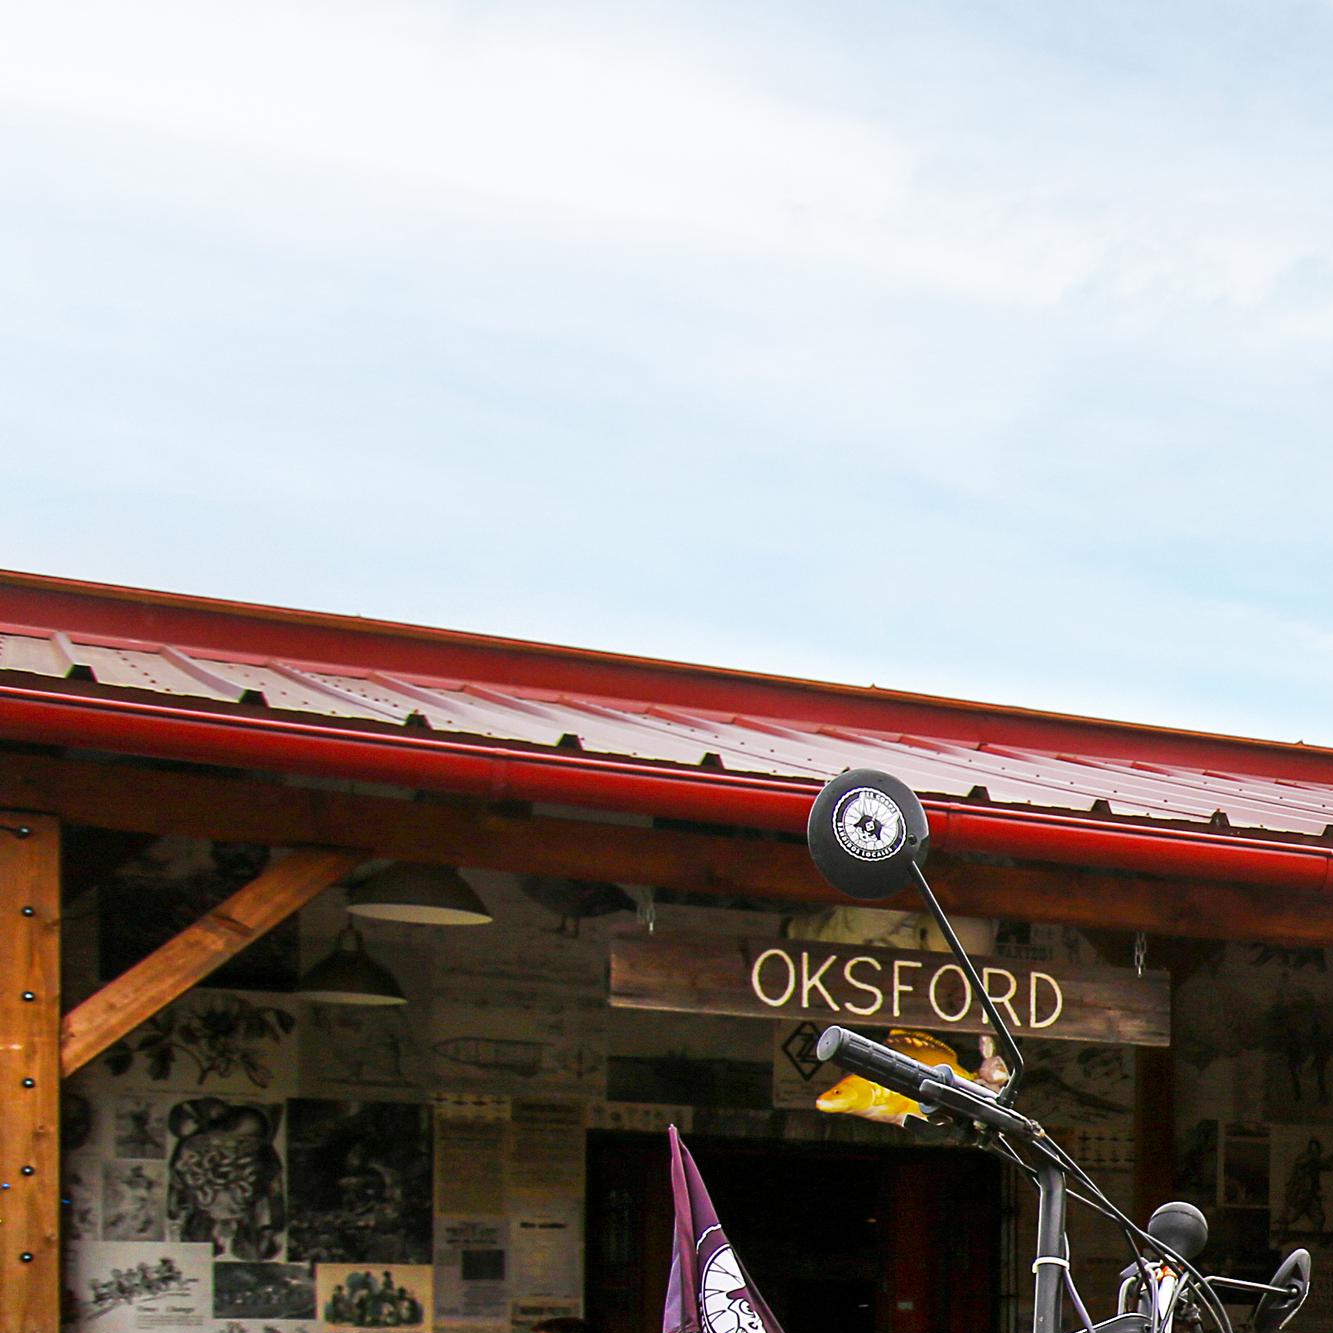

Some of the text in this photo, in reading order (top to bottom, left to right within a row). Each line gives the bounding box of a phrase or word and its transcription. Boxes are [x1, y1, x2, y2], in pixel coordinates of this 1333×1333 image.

[837, 821, 893, 858] BANDIDOS LOCALES
[752, 948, 1063, 1028] OKSFORD
